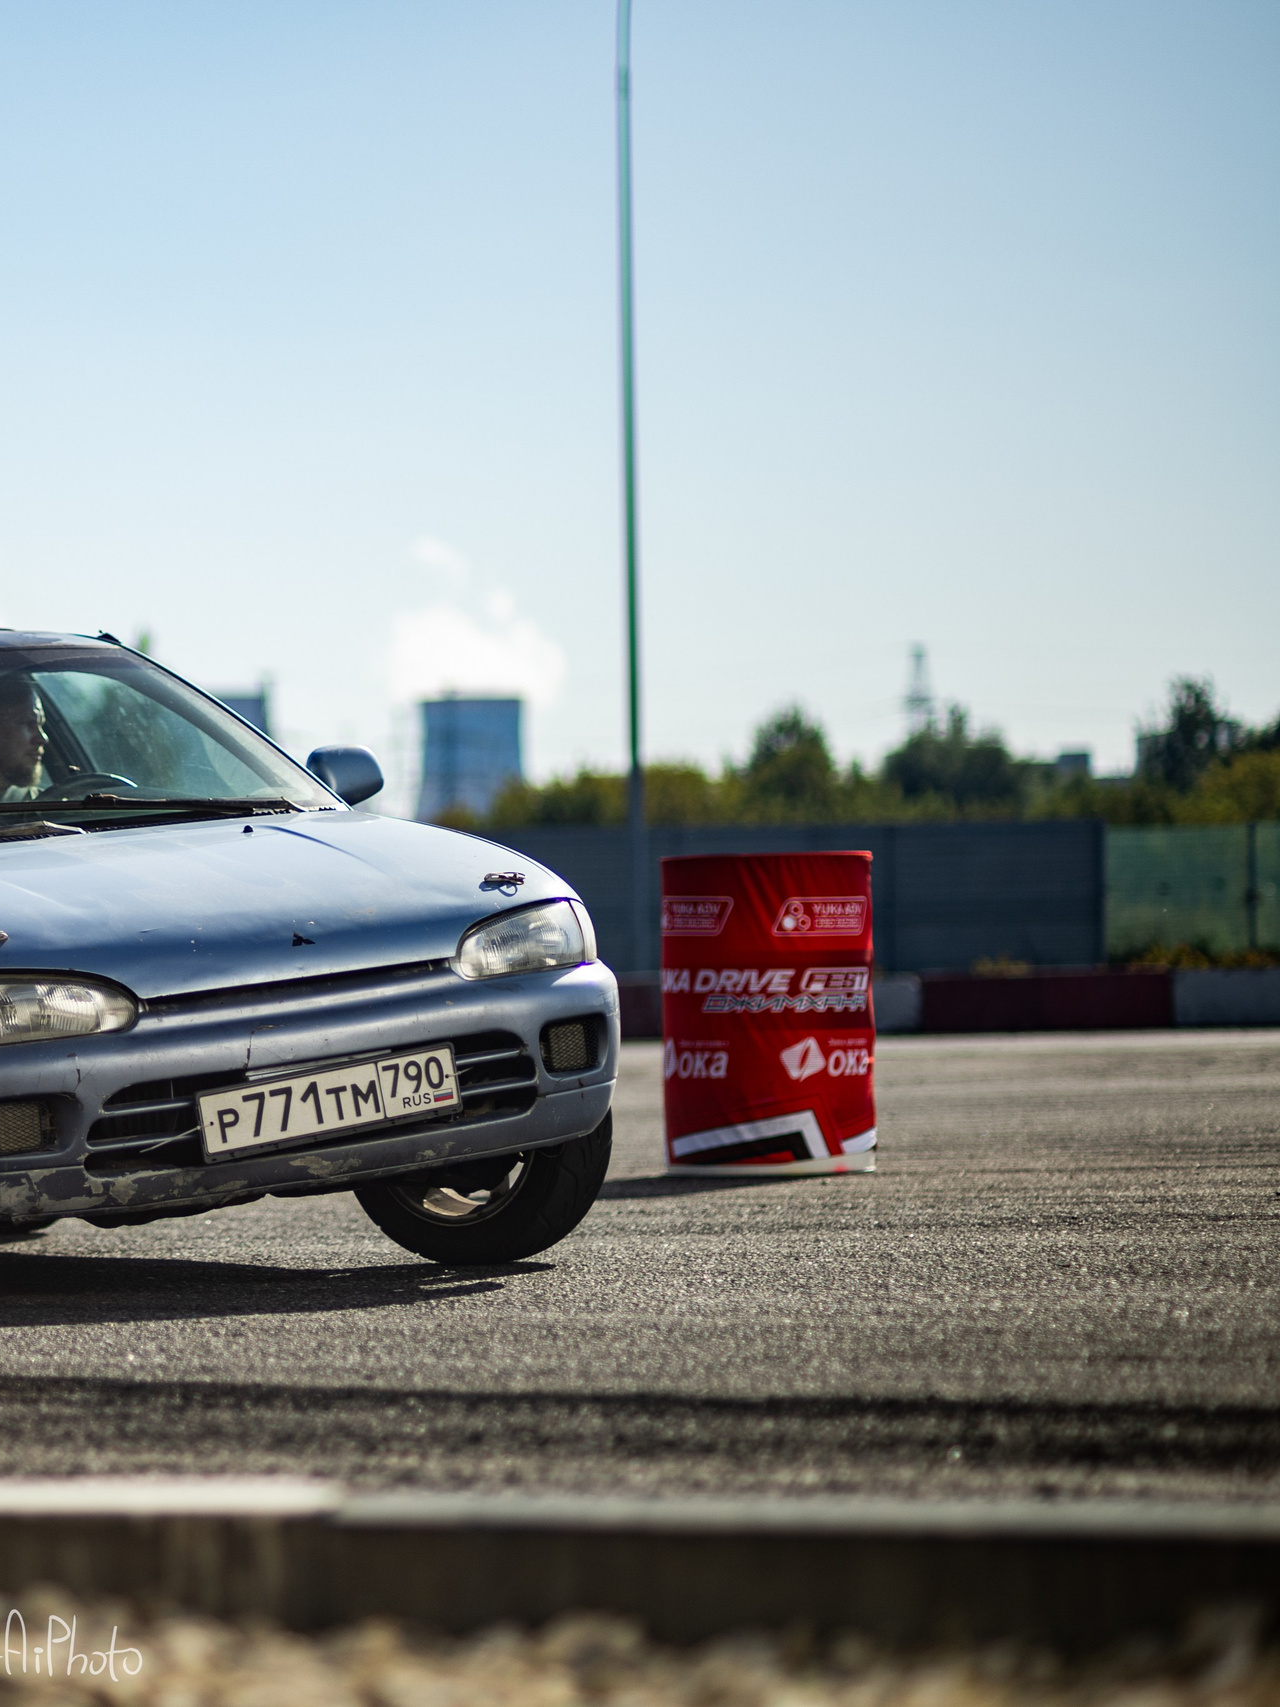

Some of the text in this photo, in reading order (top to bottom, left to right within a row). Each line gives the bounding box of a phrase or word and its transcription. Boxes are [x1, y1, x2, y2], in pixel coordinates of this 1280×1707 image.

[693, 969, 796, 993] DRIVE
[381, 1056, 445, 1099] 790
[402, 1092, 432, 1109] RUS
